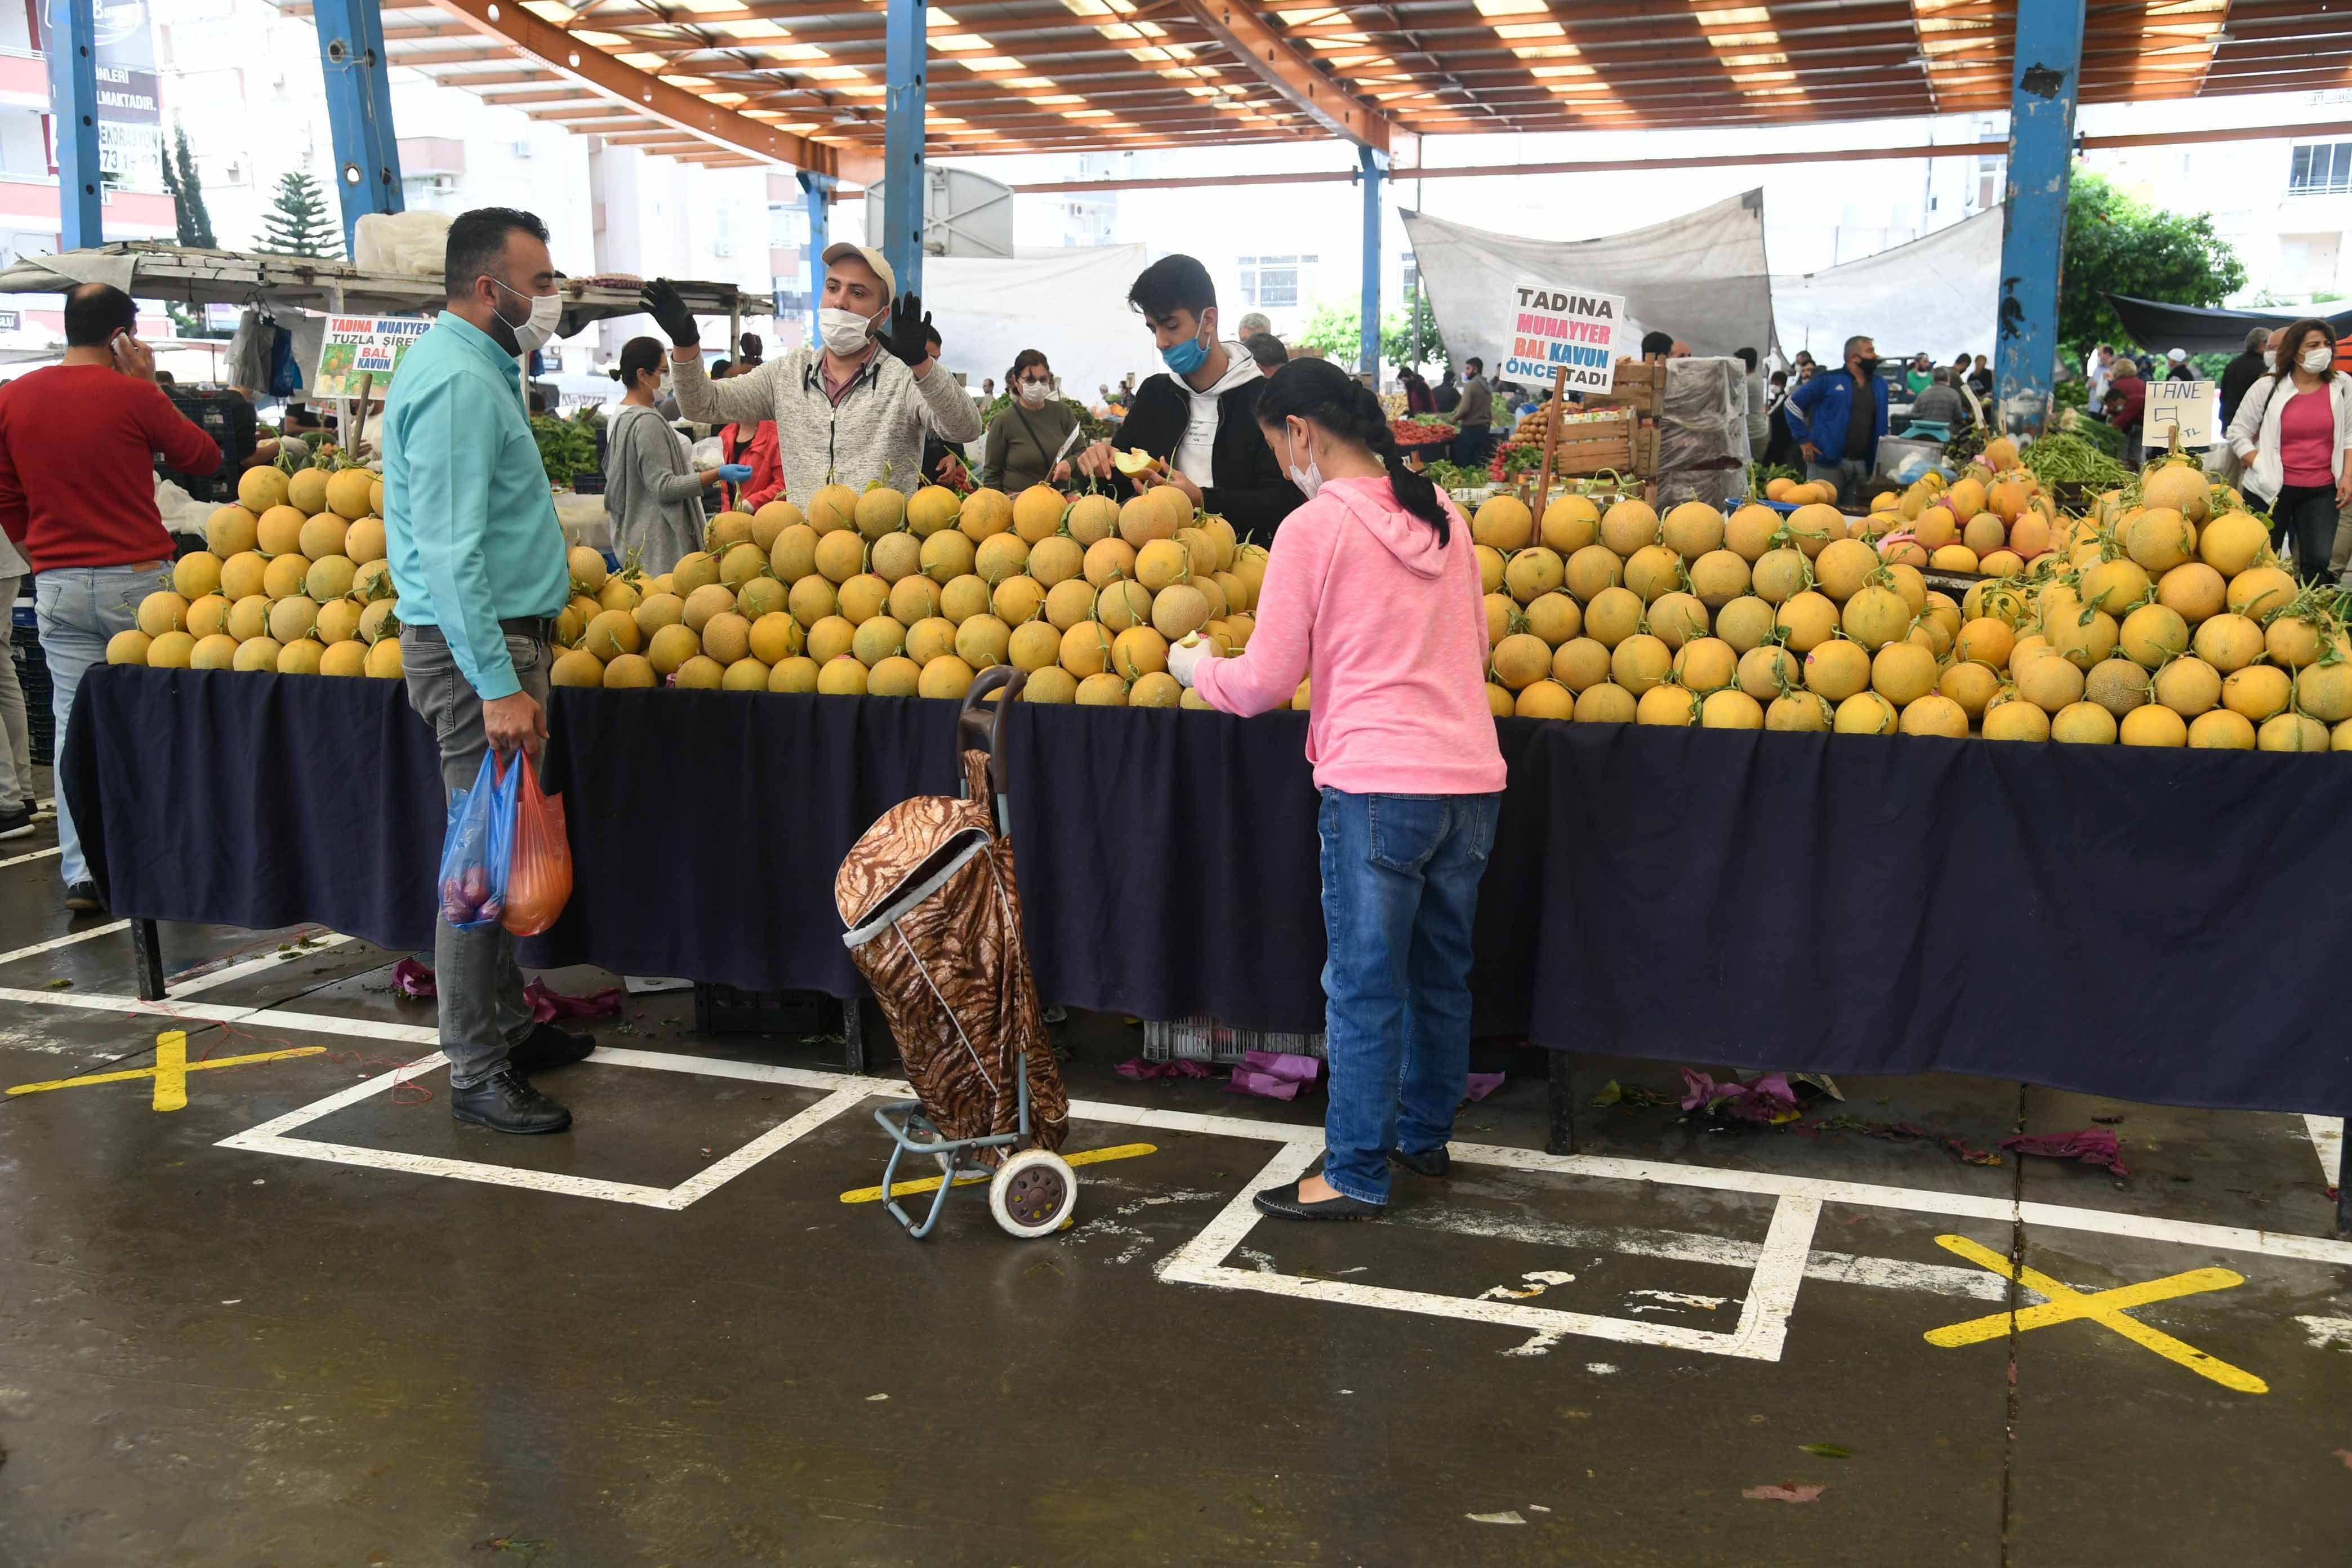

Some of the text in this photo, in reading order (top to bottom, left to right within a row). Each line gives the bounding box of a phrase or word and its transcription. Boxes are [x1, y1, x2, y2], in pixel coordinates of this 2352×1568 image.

[1517, 288, 1613, 319] TADINA
[332, 319, 372, 333] TADINA
[1516, 313, 1611, 345] MUHAYYER
[332, 334, 417, 348] TUZLA ŞİRE
[362, 347, 388, 358] BAL
[1513, 337, 1609, 368] BAL KAVUN
[357, 358, 391, 370] KAVUN
[1506, 357, 1607, 386] ÖNCE TADI
[2148, 382, 2204, 399] TANE
